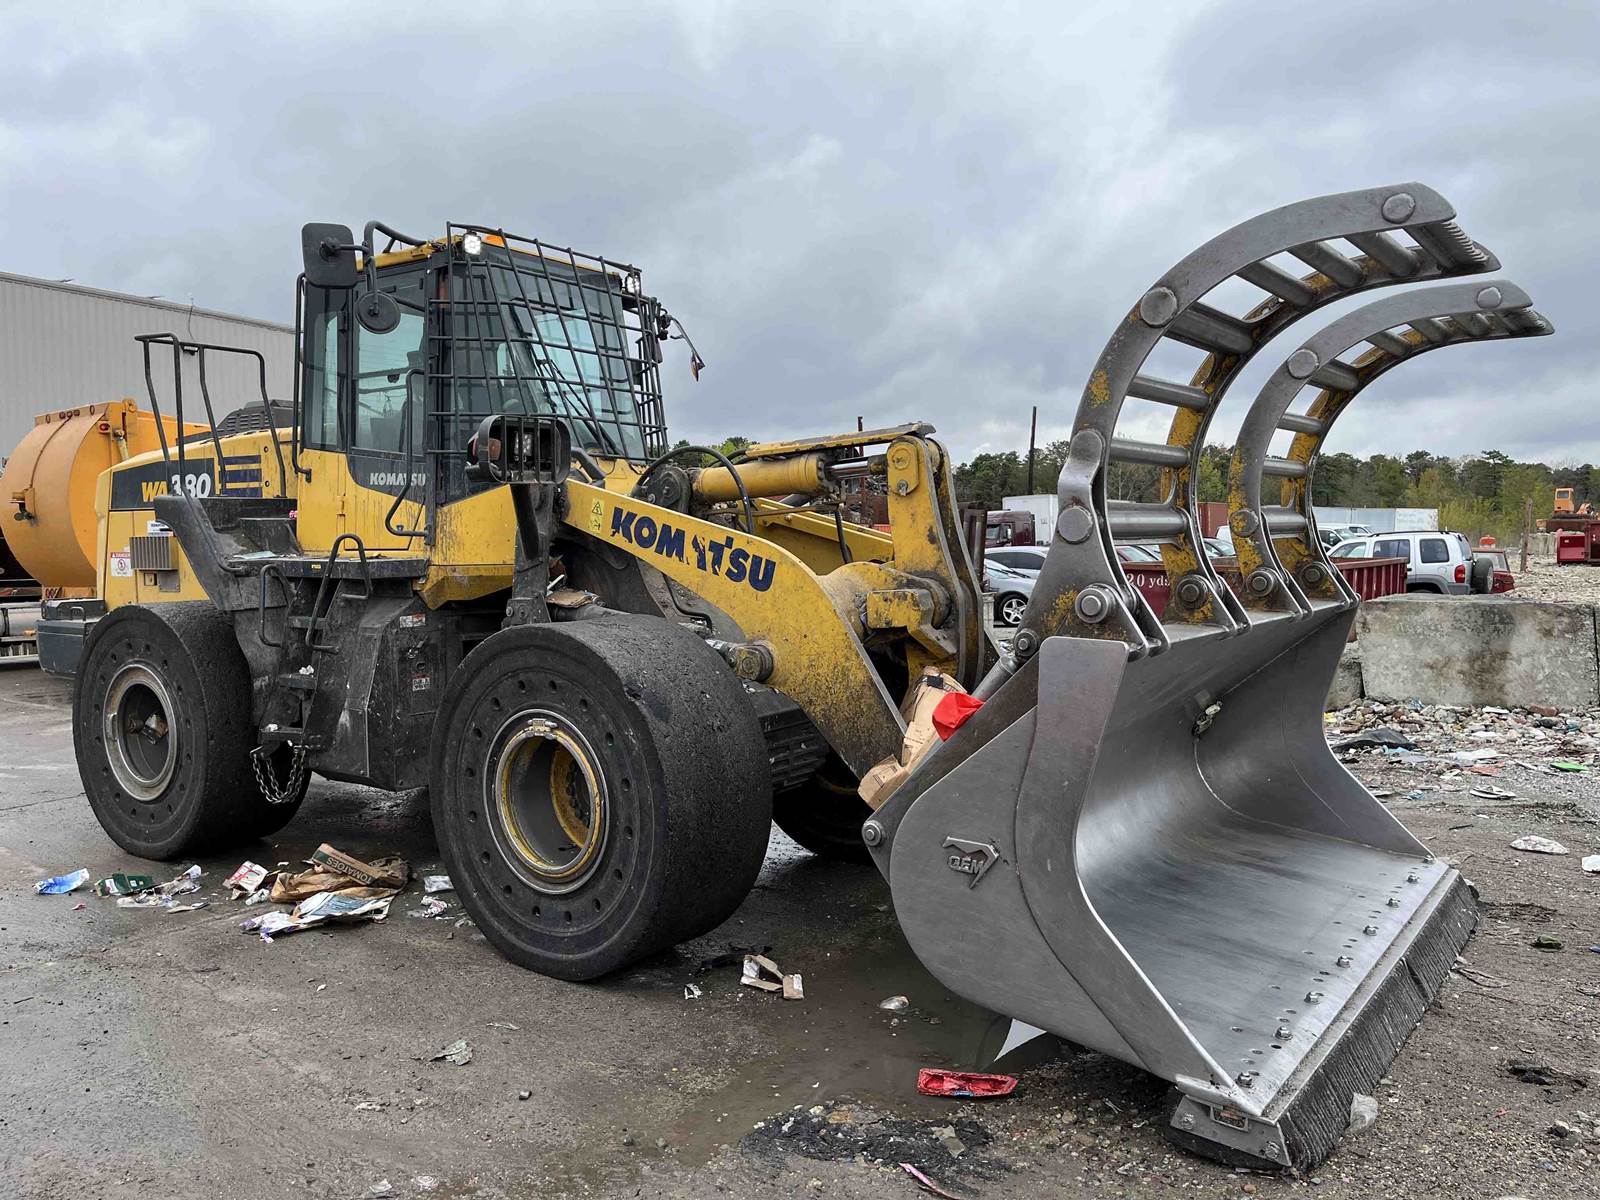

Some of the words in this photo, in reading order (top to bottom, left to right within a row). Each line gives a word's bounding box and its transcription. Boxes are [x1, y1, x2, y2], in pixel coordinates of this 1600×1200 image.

[369, 472, 426, 487] KOMASU
[1126, 573, 1145, 587] 20
[326, 857, 372, 884] TOMATOES
